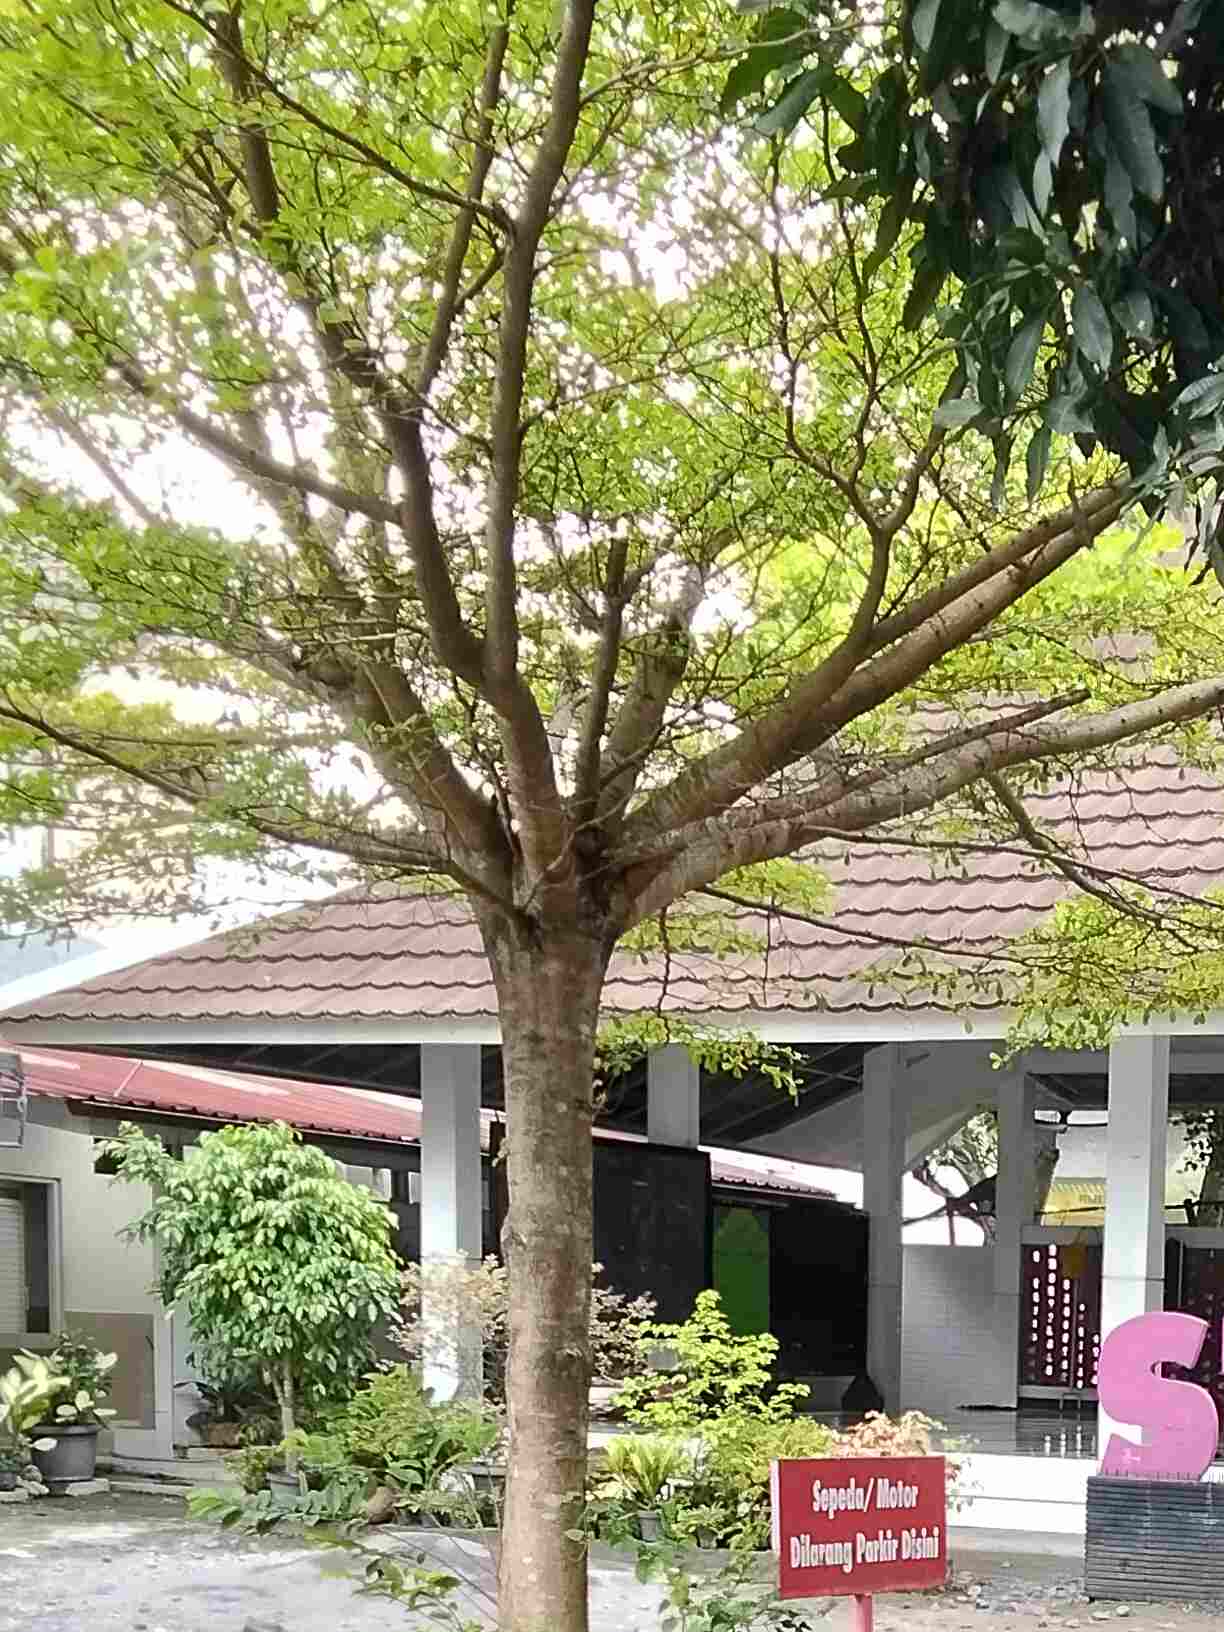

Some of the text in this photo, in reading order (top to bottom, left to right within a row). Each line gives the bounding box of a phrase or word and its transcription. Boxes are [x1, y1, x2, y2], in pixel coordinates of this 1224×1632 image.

[876, 1478, 918, 1509] Motor
[790, 1526, 939, 1573] Dilarang Parkir Disini
